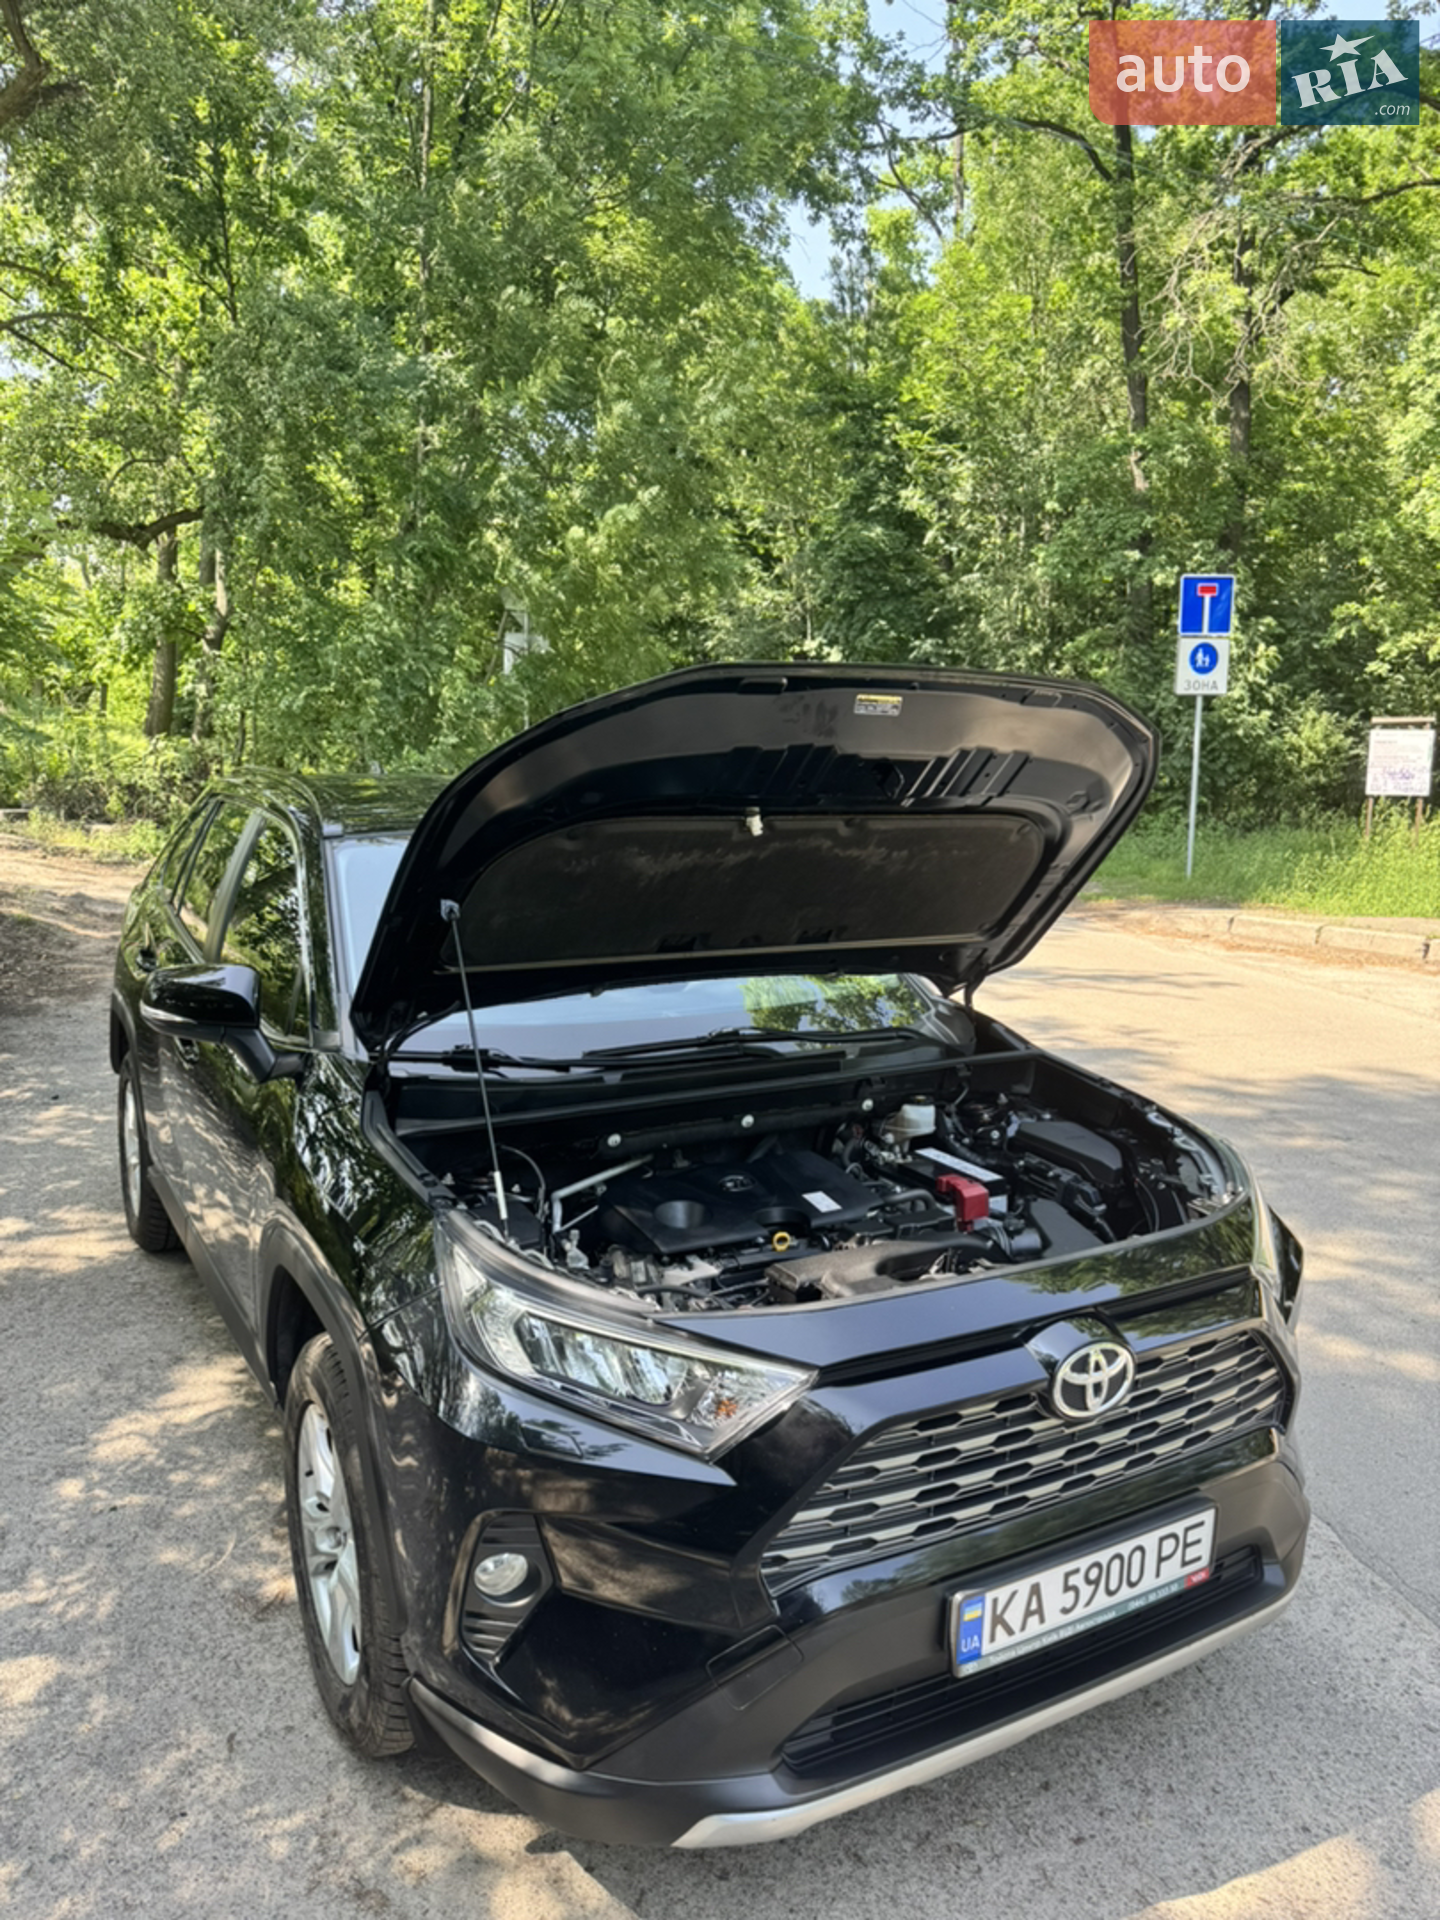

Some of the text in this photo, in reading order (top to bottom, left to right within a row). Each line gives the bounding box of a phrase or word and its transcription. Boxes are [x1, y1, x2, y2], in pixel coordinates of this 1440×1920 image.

[1183, 680, 1219, 692] ЗОНА
[988, 1520, 1206, 1644] KA 5900 PE
[961, 1634, 981, 1653] UA
